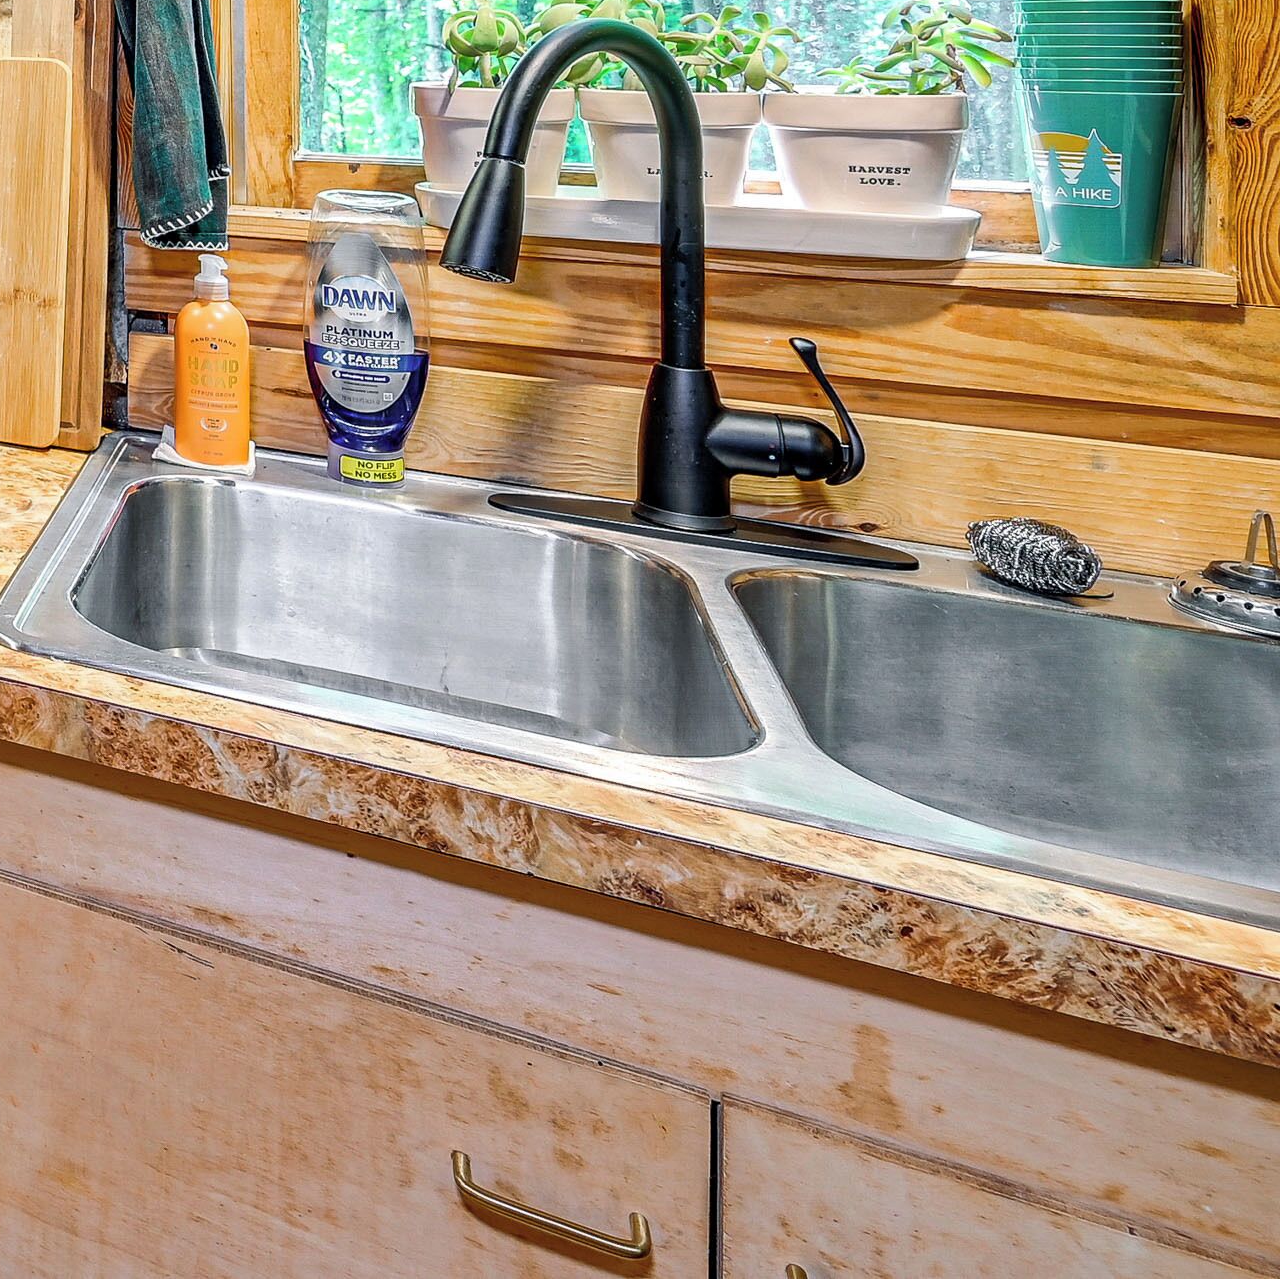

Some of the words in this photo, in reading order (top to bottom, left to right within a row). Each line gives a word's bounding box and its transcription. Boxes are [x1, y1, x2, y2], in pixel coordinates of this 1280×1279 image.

[848, 165, 912, 175] HARVEST
[859, 177, 902, 187] LOVE.
[1055, 186, 1068, 197] A
[1072, 187, 1112, 200] HIKE
[322, 284, 396, 312] DAWN
[326, 325, 394, 339] PLATINUM
[322, 333, 400, 350] EZ-SQUEEZE
[188, 356, 239, 373] HAND
[323, 351, 347, 365] 4X
[190, 372, 238, 389] SOAP
[357, 461, 374, 469] NO
[376, 462, 395, 470] FLIP
[355, 470, 371, 479] NO
[374, 471, 397, 480] MESS
